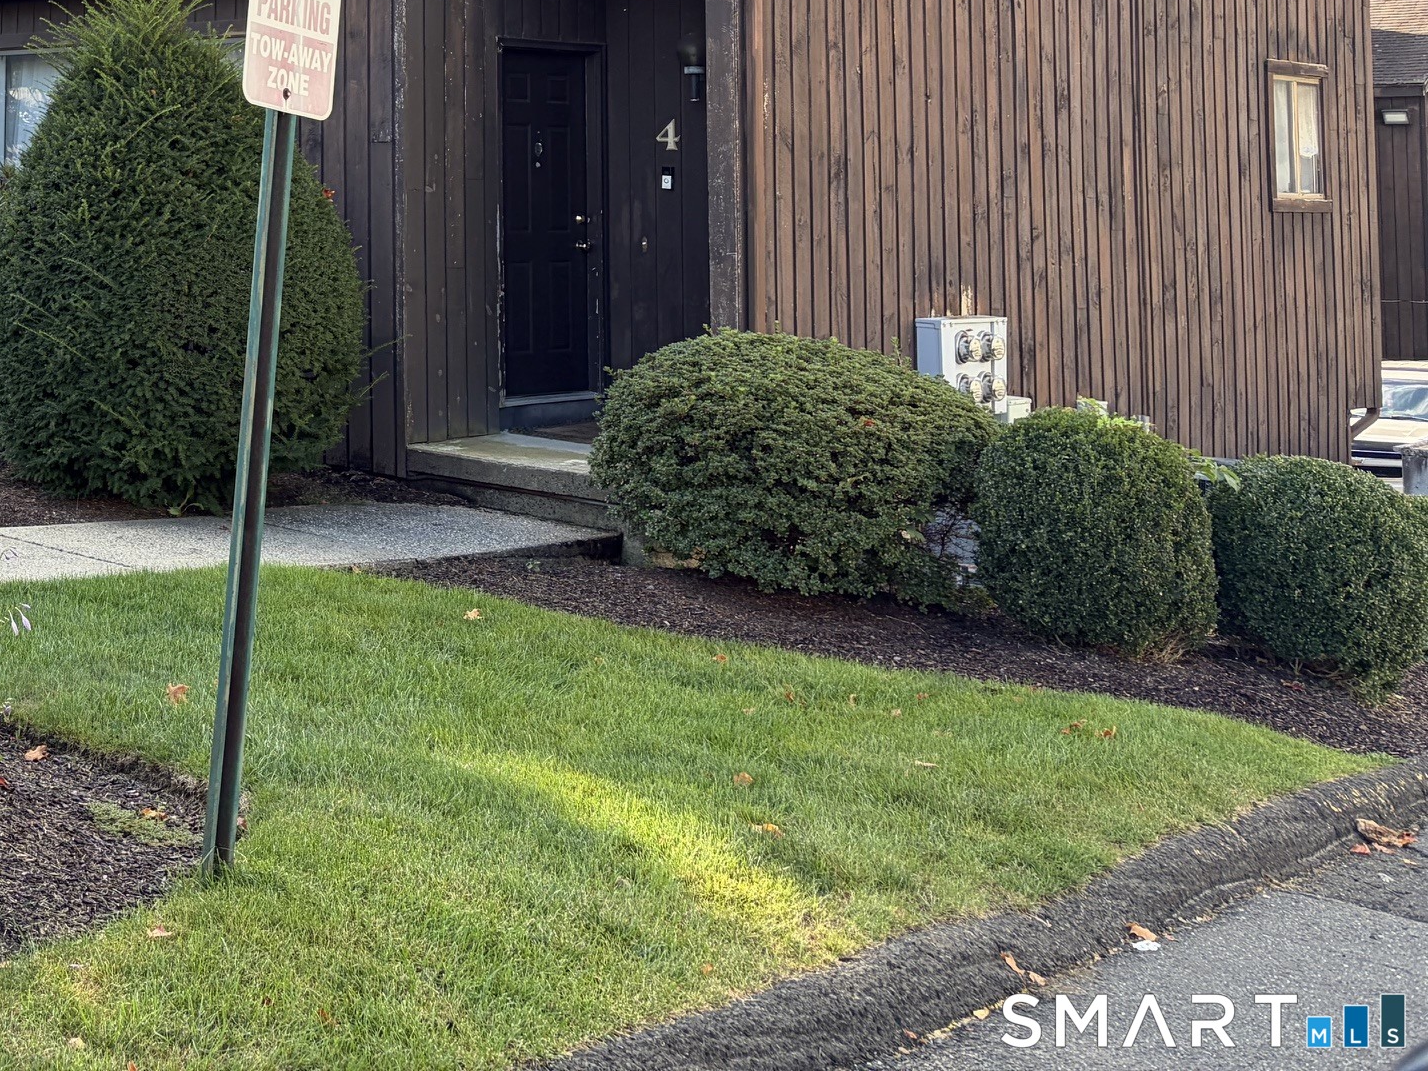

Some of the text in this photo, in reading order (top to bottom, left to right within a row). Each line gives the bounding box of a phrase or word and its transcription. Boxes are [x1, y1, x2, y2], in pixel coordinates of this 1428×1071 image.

[251, 34, 332, 73] TOW-AWAY
[267, 66, 310, 97] ZONE
[655, 118, 681, 151] 4
